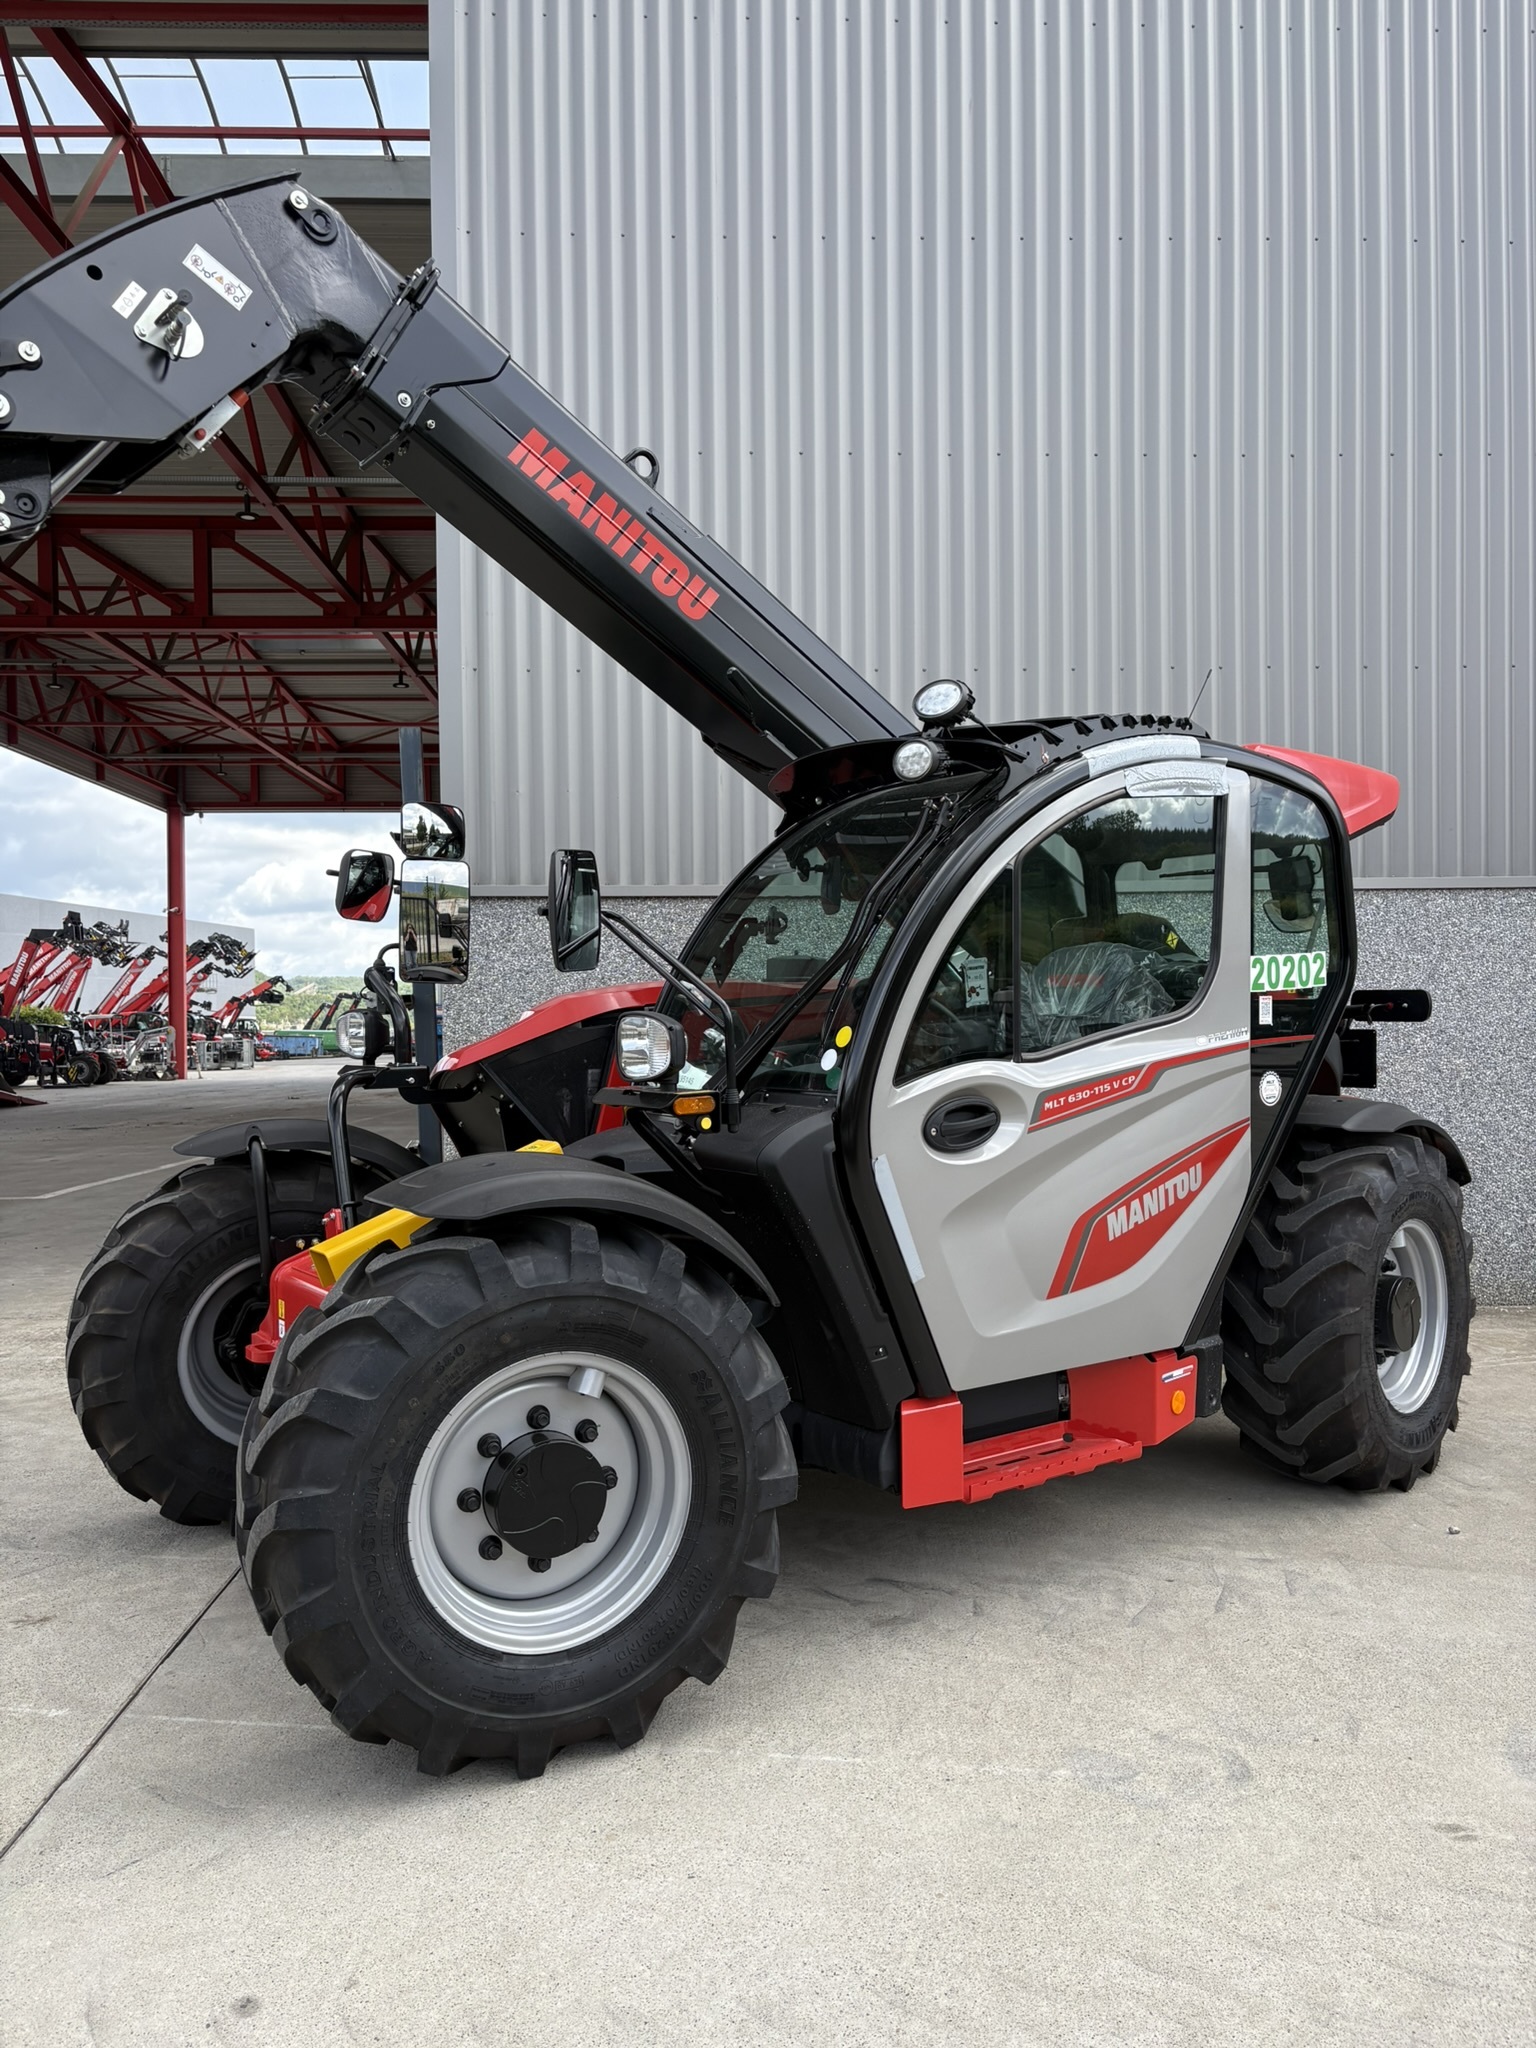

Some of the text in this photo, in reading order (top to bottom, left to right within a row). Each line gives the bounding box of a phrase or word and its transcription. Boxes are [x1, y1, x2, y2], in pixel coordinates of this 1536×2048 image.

[507, 427, 720, 622] MANITOU
[9, 951, 29, 987] MANITOU
[1251, 953, 1326, 991] 20202
[1208, 1027, 1249, 1044] PREMIUM
[1044, 1075, 1136, 1111] MLT 630-115 V CP
[1106, 1161, 1203, 1242] MANITOU
[695, 1392, 739, 1528] ALLIANCE
[360, 1461, 433, 1668] AGRO INDUSTRIAL
